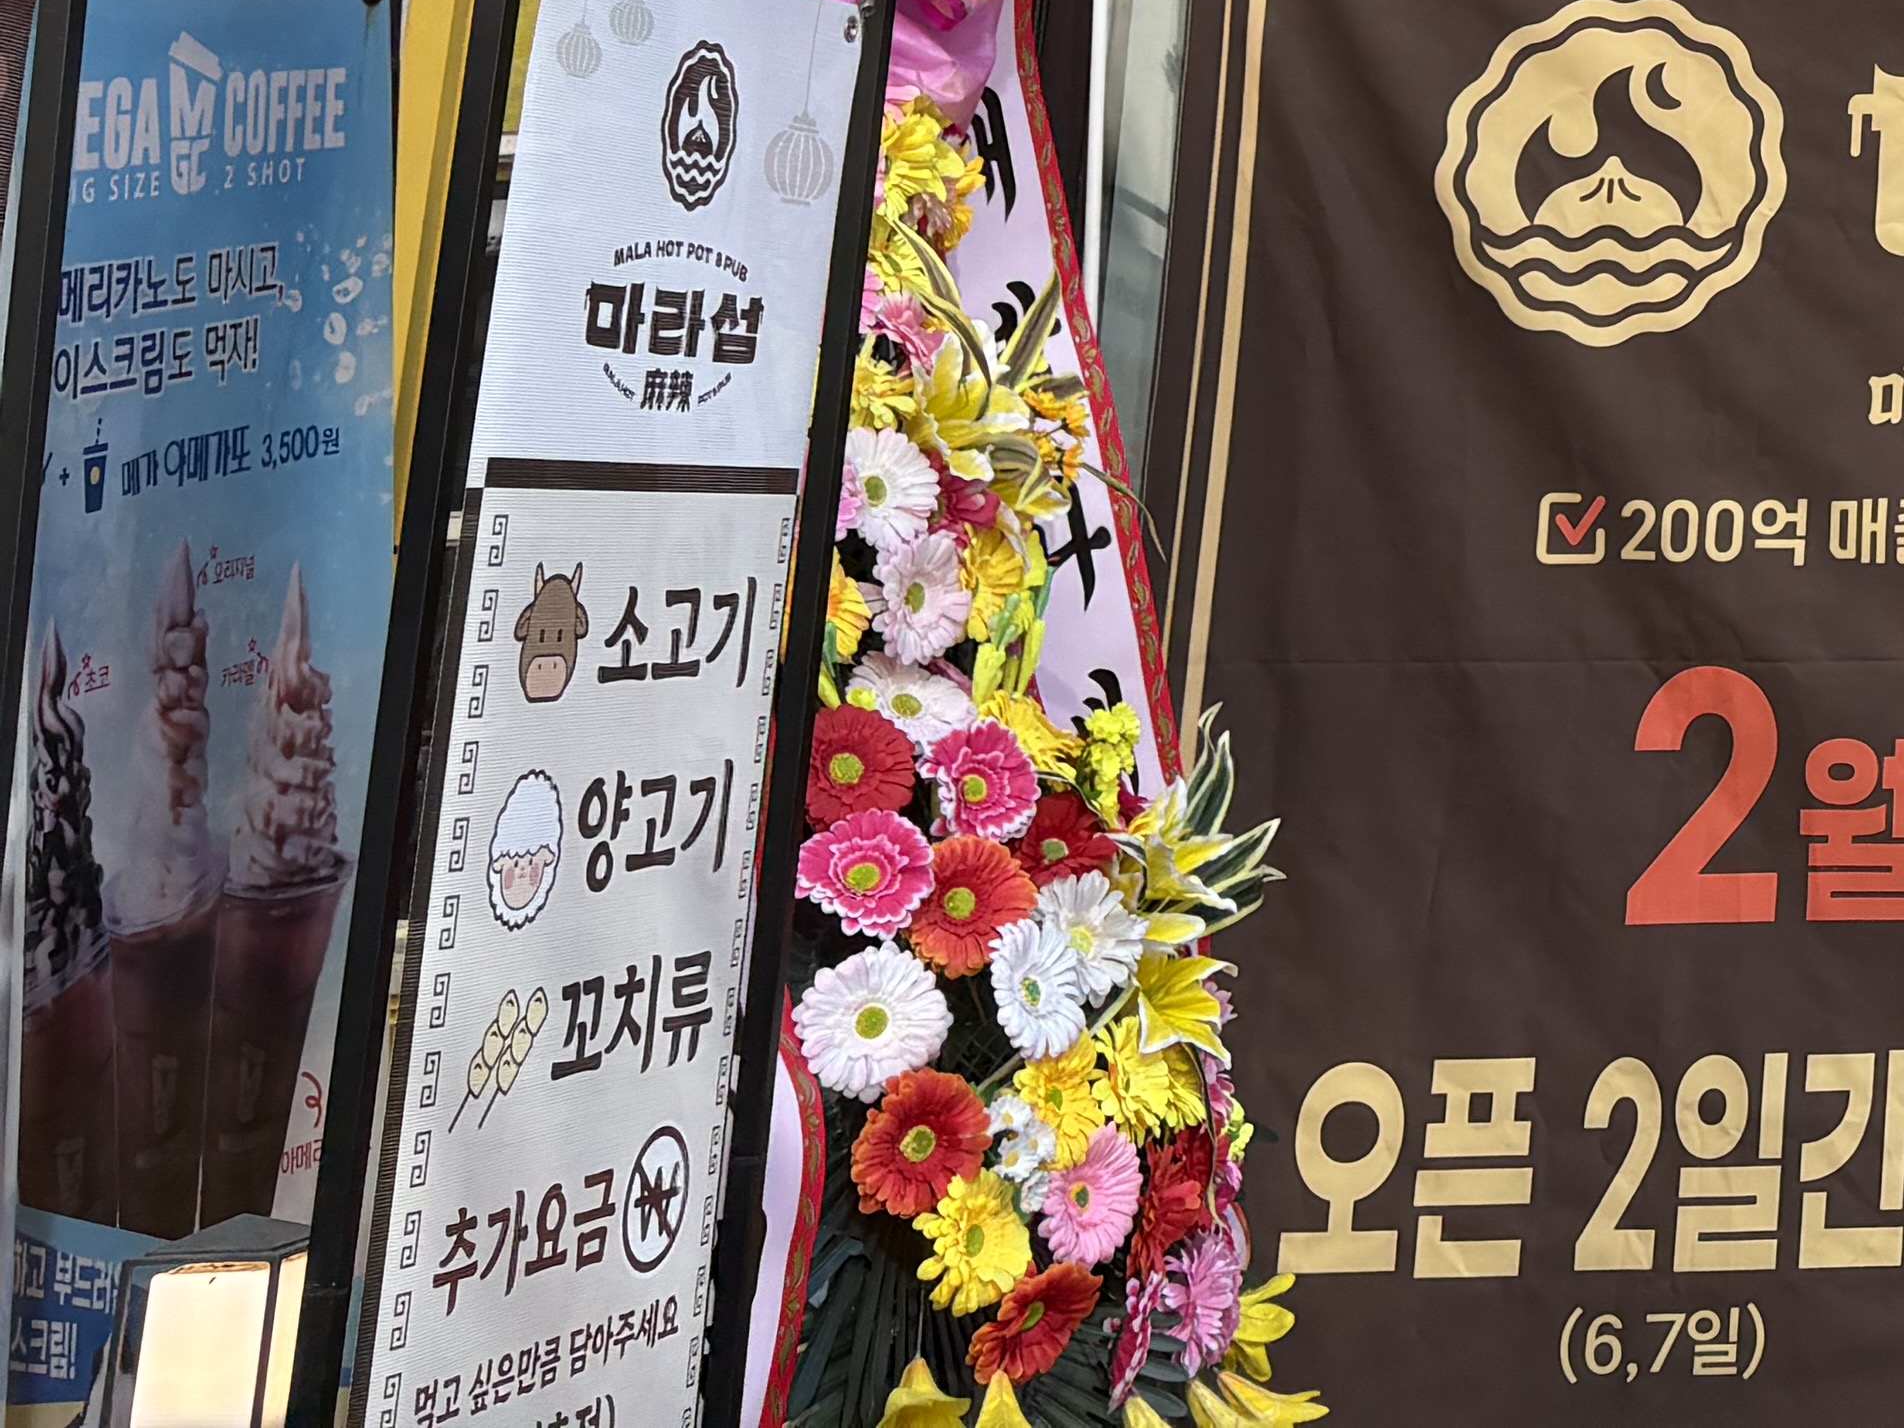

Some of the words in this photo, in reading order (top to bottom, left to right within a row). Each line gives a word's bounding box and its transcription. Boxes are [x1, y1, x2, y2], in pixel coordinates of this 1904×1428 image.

[223, 67, 347, 157] COFFEE
[108, 172, 161, 201] SIZE
[223, 165, 234, 189] 2
[247, 158, 307, 186] SHOT
[207, 243, 285, 302] 마시고,
[613, 241, 652, 267] MALA
[655, 239, 684, 258] HOT
[687, 242, 713, 264] POT
[723, 254, 749, 283] PUB
[53, 330, 195, 400] 이스크림도
[205, 318, 259, 384] 먹자!
[121, 449, 159, 497] 메가
[260, 425, 341, 470] 3,500원
[1620, 498, 1808, 567] 200억
[598, 576, 757, 688] 소고기
[578, 758, 734, 893] 양고기
[550, 950, 713, 1081] 꼬치류
[1276, 1055, 1537, 1280] 오픈
[432, 1168, 617, 1316] 추가요금
[414, 1375, 460, 1428] 먹고
[468, 1335, 561, 1416] 싶은만큼
[569, 1294, 679, 1378] 담아주세요
[1559, 1302, 1767, 1385] (6,7일)
